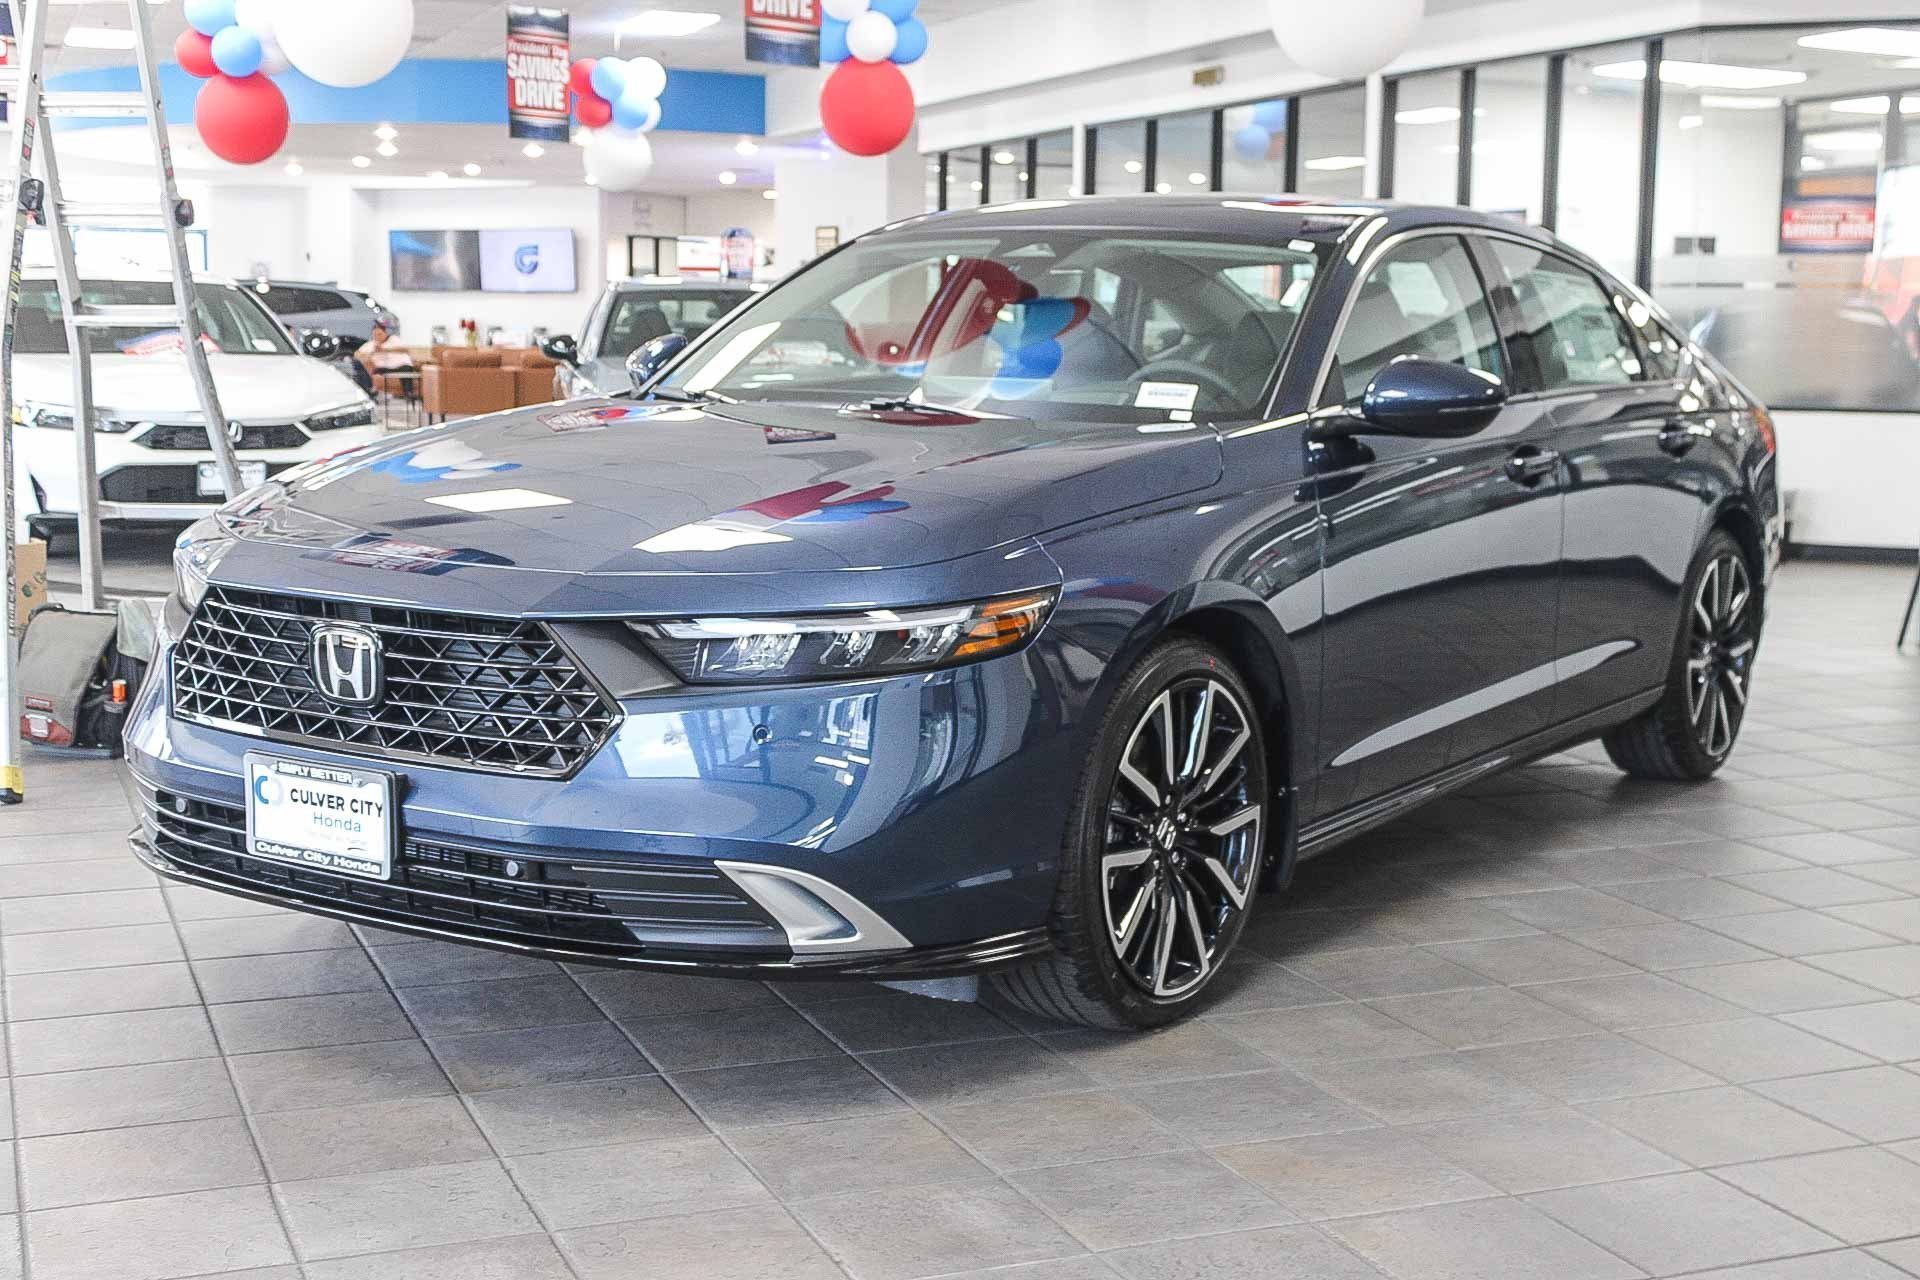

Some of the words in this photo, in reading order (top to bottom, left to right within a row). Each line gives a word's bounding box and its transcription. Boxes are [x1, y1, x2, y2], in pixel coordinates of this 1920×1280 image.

[508, 53, 570, 84] SAVINGS
[515, 79, 565, 110] DRIVE
[311, 767, 353, 784] BETTER
[290, 788, 345, 811] CULVER
[350, 798, 384, 818] CITY
[313, 811, 362, 833] Honda
[256, 841, 302, 859] Culver
[303, 850, 332, 866] City
[333, 855, 381, 875] Honda
